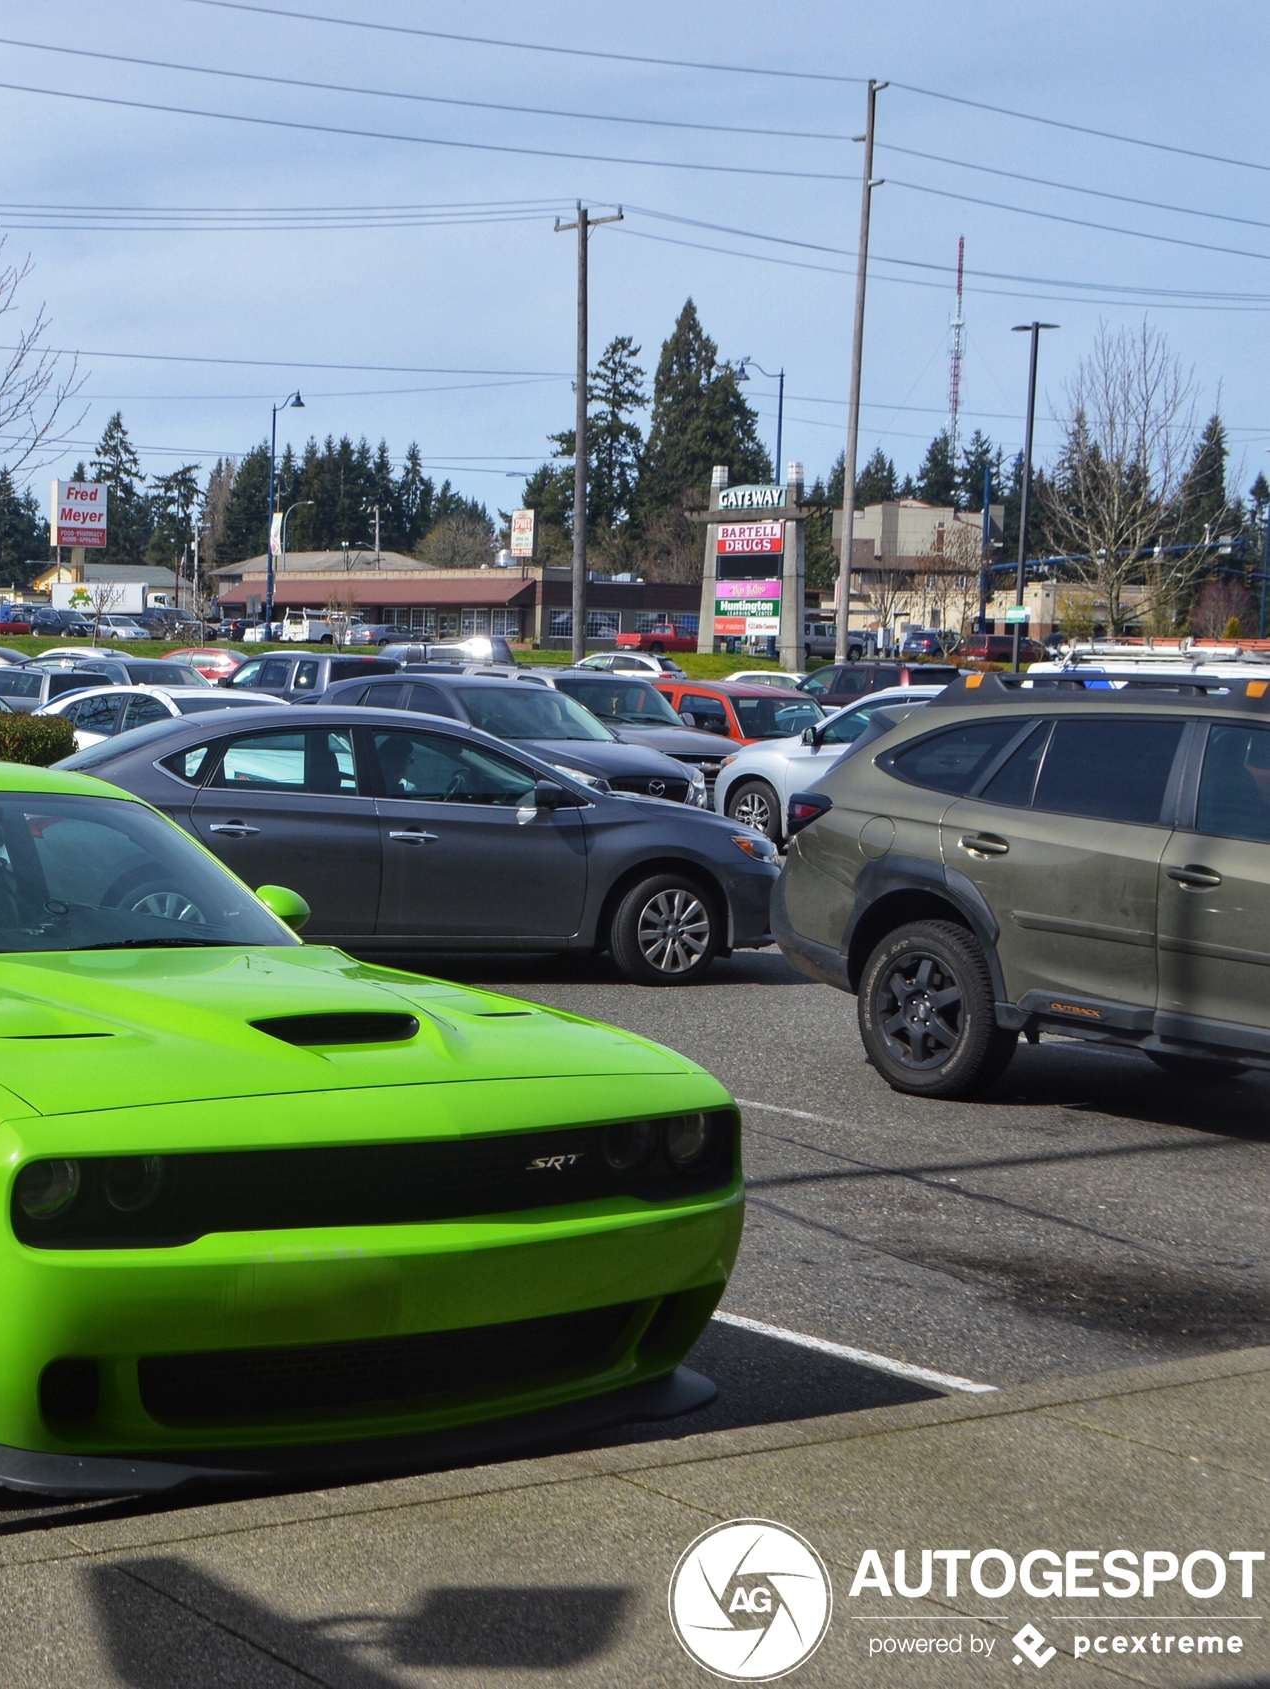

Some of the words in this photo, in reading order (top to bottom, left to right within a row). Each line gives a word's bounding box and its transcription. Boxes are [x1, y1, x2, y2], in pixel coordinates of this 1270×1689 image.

[66, 487, 99, 501] Fred
[719, 489, 782, 507] GATEWAY
[60, 508, 104, 525] Meyer
[721, 526, 777, 538] BARTELL
[725, 540, 772, 551] DRUGS
[720, 601, 773, 613] Huntington
[1051, 1003, 1100, 1017] OUTBACK
[526, 1153, 584, 1170] SRT
